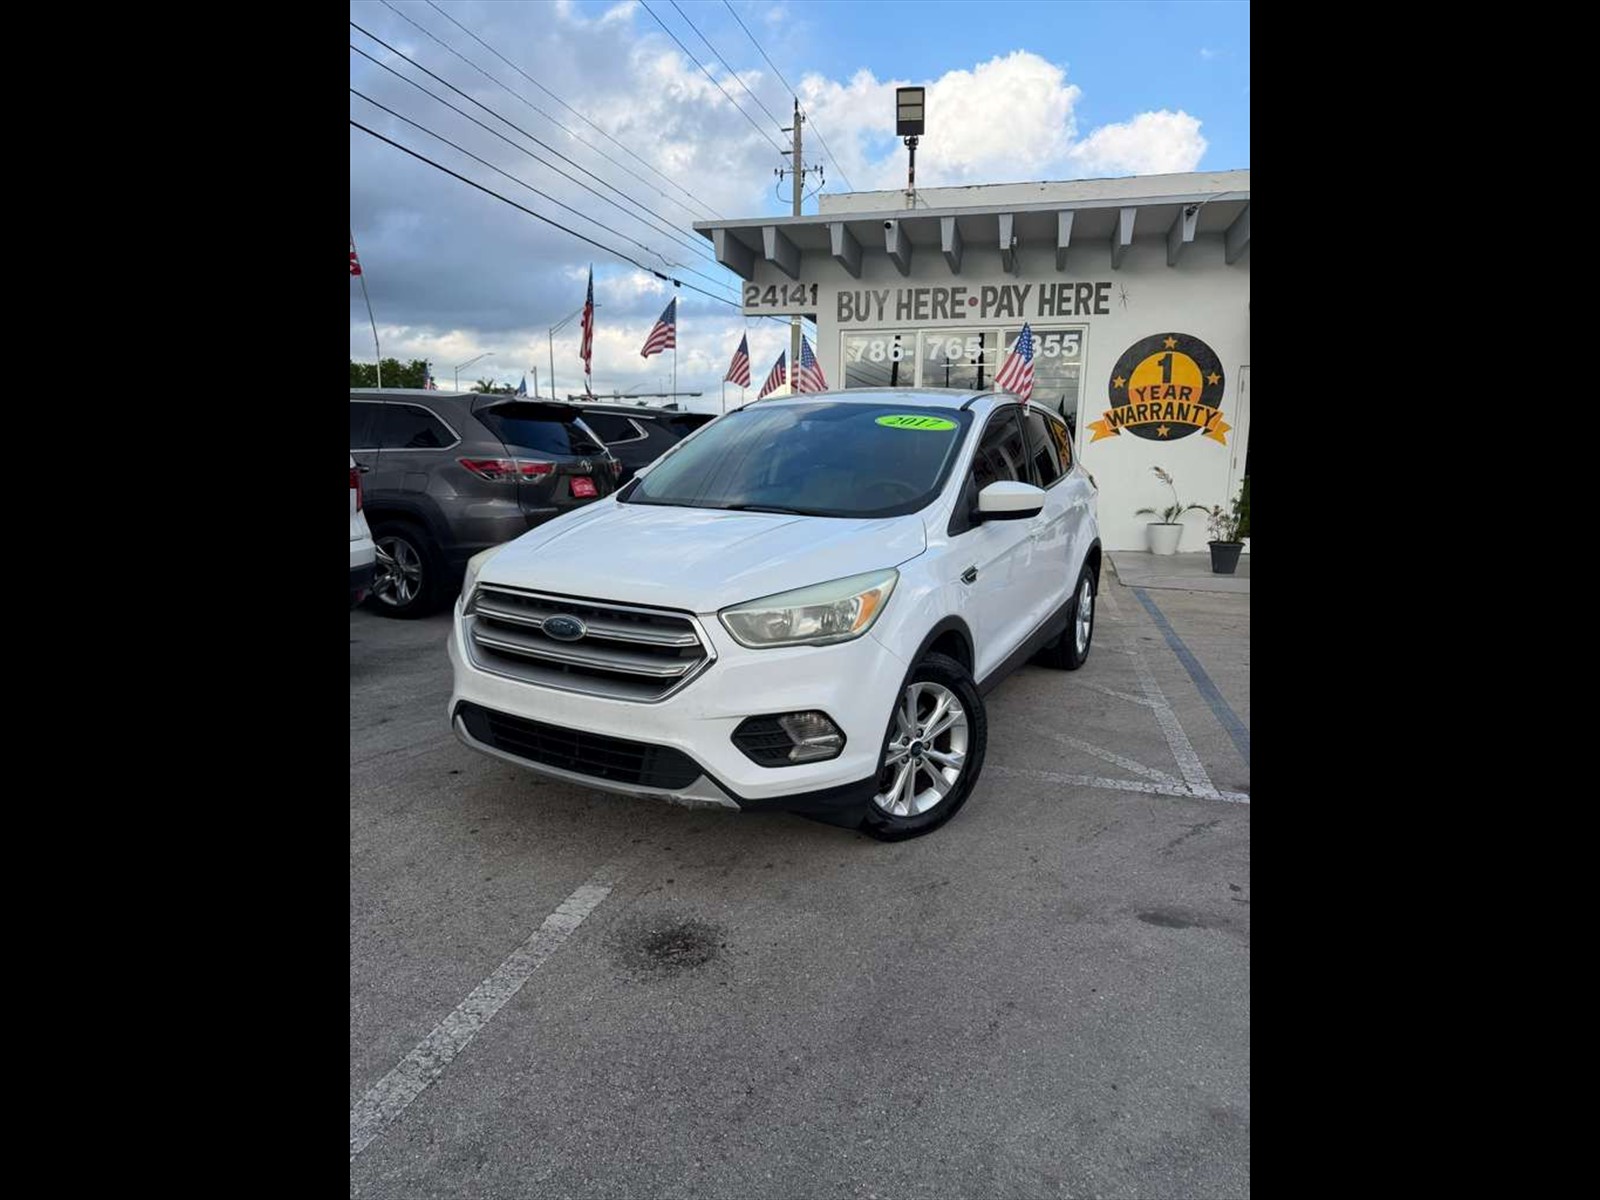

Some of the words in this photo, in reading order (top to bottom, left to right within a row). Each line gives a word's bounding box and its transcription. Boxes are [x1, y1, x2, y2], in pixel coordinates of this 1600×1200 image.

[744, 283, 819, 308] 24141
[836, 289, 891, 323] BUY
[896, 286, 968, 321] HERE
[980, 284, 1033, 319] PAY
[1037, 281, 1113, 317] HERE
[1157, 352, 1174, 384] 1
[1135, 384, 1194, 402] YEAR
[1104, 402, 1220, 428] WARRANTY
